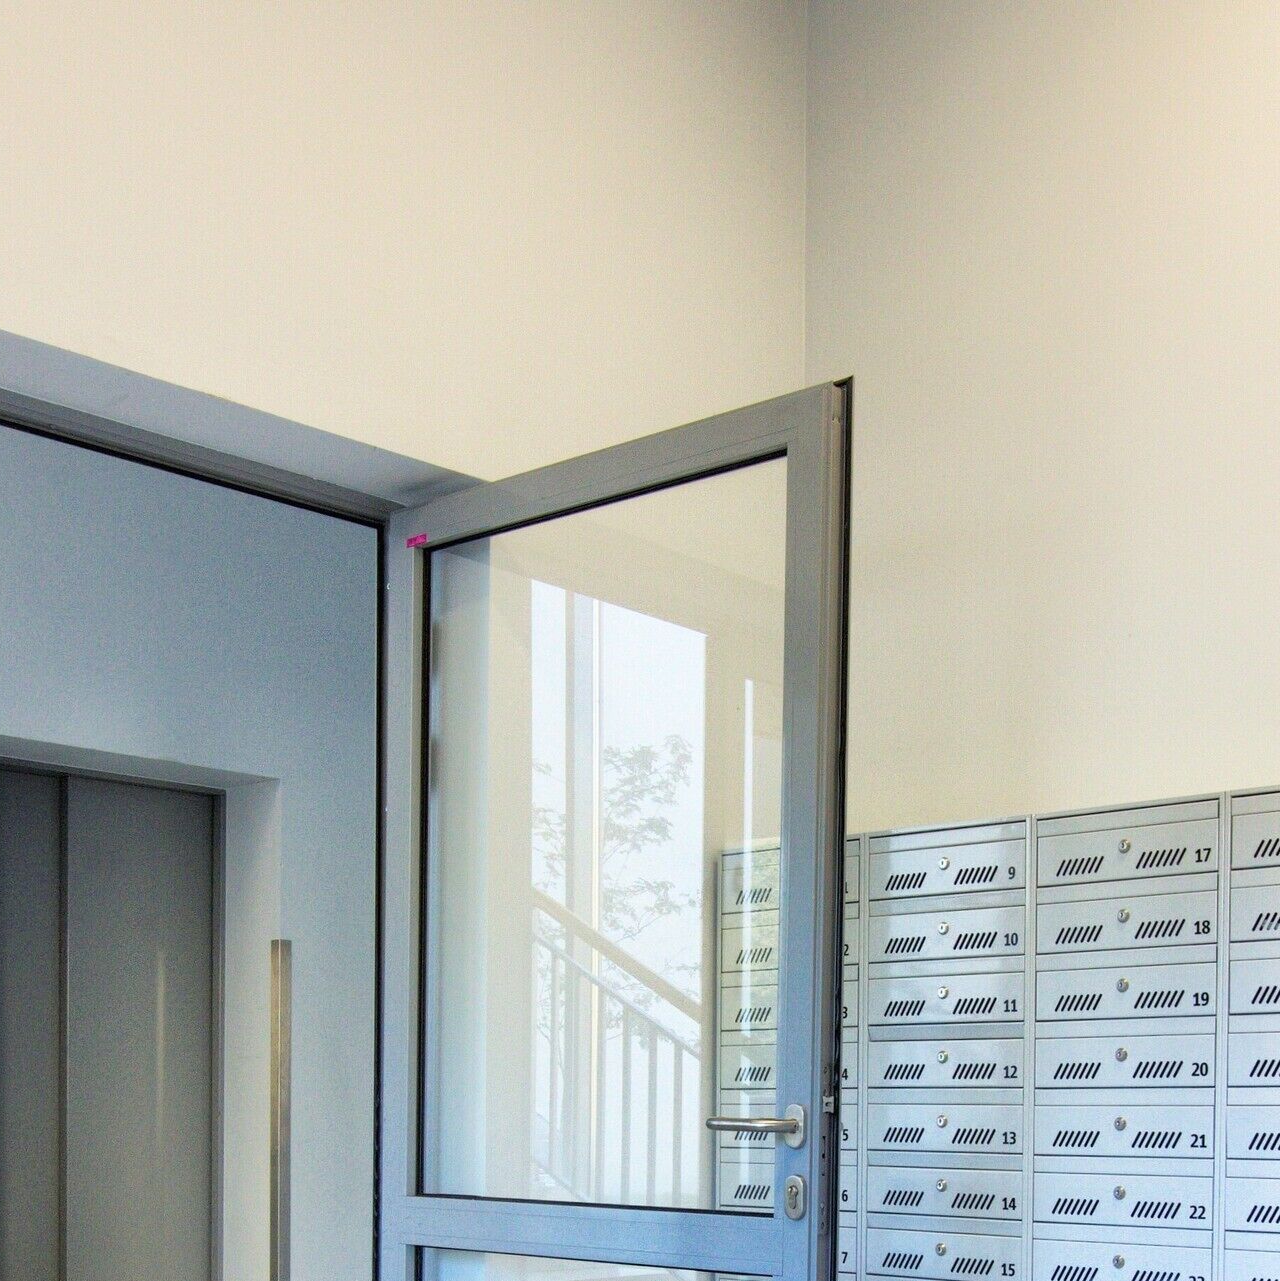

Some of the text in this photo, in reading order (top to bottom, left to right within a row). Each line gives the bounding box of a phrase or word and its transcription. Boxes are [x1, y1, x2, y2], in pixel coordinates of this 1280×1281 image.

[1194, 847, 1212, 863] 17
[1006, 865, 1017, 881] 9
[1193, 920, 1211, 936] 18
[1003, 932, 1019, 947] 10
[843, 944, 850, 957] 2
[1003, 998, 1018, 1013] 11
[1192, 991, 1210, 1007] 19
[841, 1068, 849, 1081] 4
[1003, 1065, 1018, 1079] 12
[1191, 1062, 1209, 1077] 20
[842, 1129, 849, 1141] 5
[1002, 1131, 1017, 1145] 13
[1190, 1133, 1208, 1149] 21
[841, 1189, 848, 1202] 6
[1001, 1197, 1017, 1211] 14
[1188, 1205, 1206, 1220] 22
[841, 1252, 848, 1264] 7
[1001, 1262, 1016, 1277] 15
